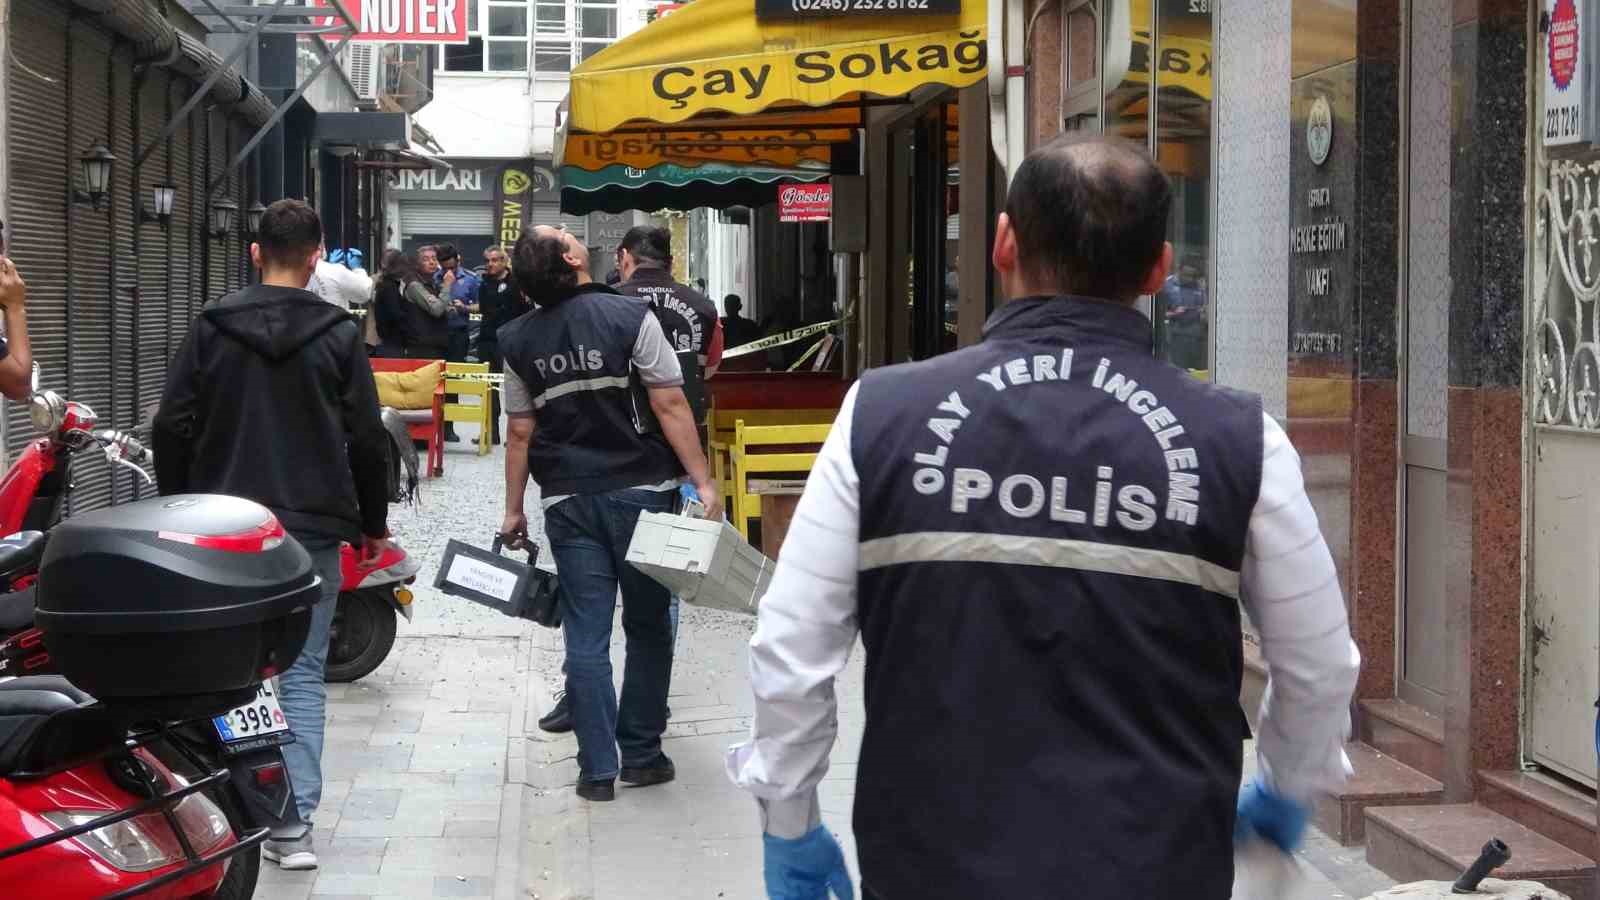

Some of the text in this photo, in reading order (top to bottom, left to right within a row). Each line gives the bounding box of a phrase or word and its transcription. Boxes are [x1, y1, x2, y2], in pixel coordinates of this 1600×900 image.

[652, 63, 771, 110] Çay
[1546, 104, 1579, 138] 223 72 81
[534, 344, 604, 379] POLİS
[912, 348, 1200, 527] OLAY YERİ İNCELEME
[950, 465, 1158, 531] POLİS
[235, 705, 273, 732] 398
